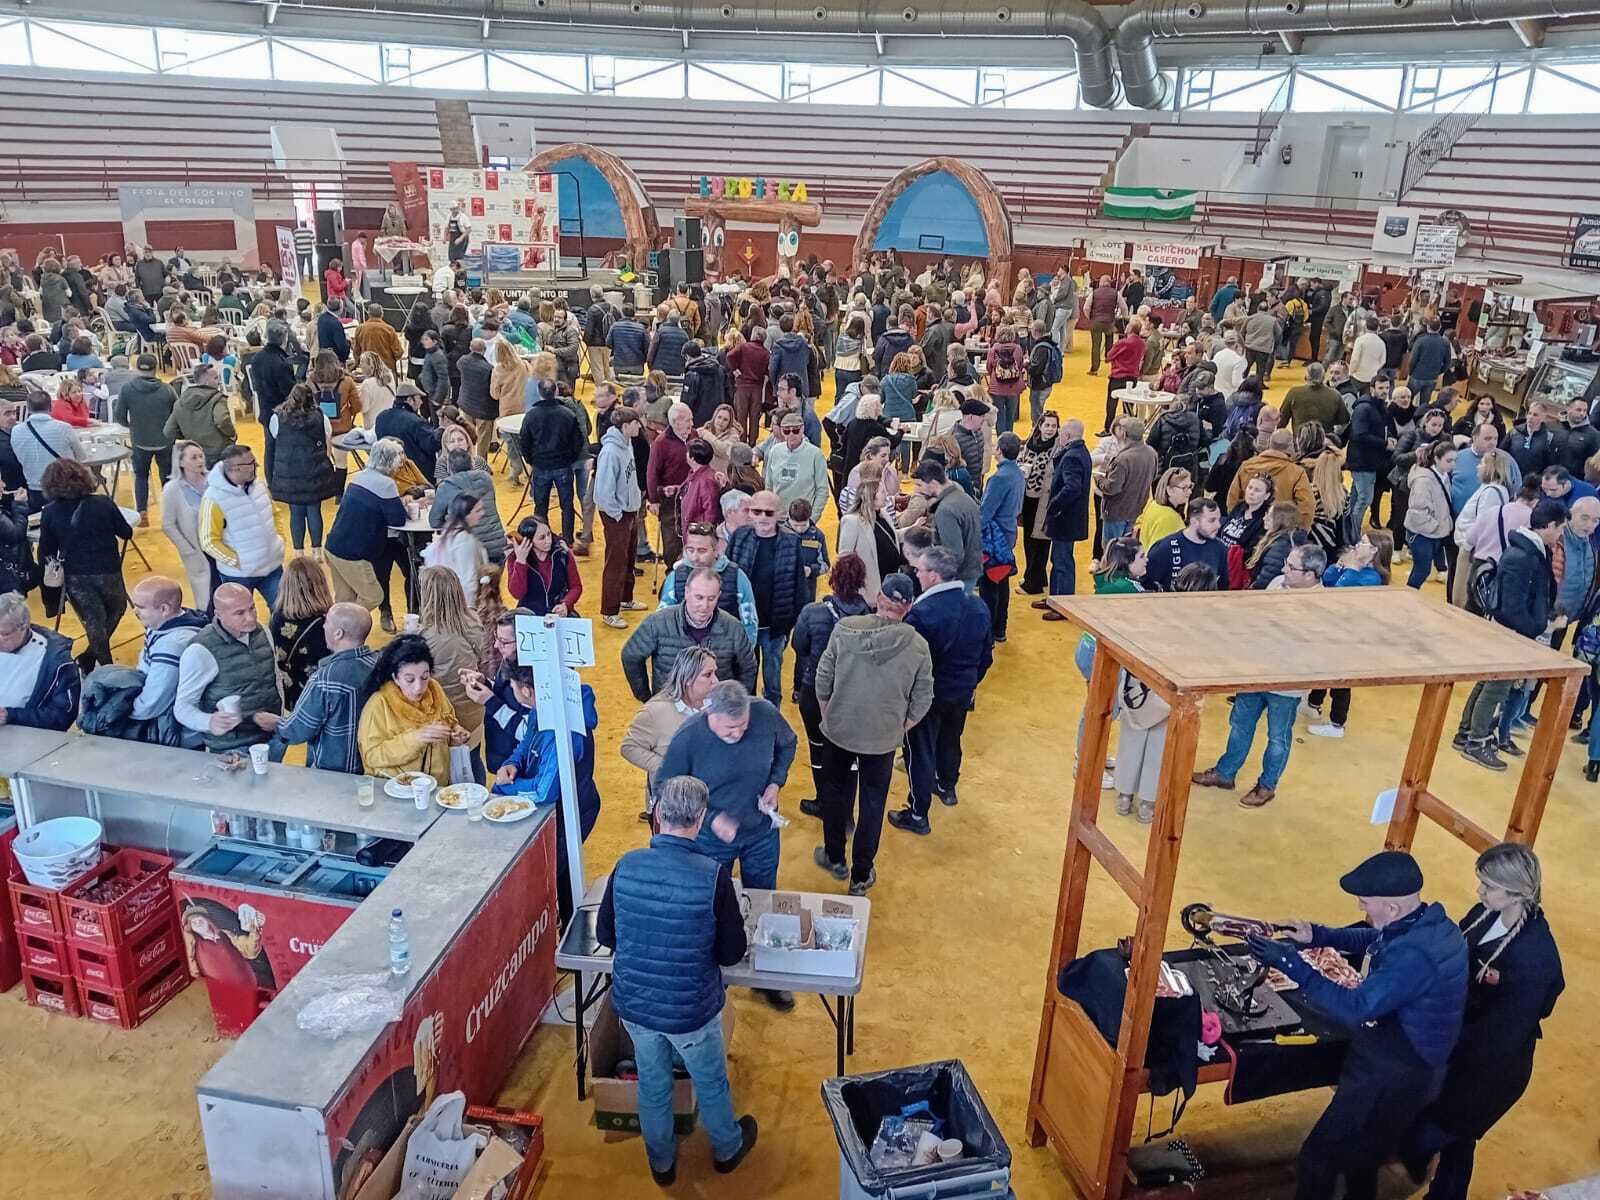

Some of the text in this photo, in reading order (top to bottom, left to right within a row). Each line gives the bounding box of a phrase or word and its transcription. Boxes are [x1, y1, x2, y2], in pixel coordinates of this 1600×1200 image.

[132, 188, 245, 197] FERIA DEL COCHINO
[1136, 244, 1199, 256] SALCHICHON
[1147, 255, 1185, 265] CASERO
[557, 290, 568, 298] DE
[465, 908, 549, 1043] Cruzcampo
